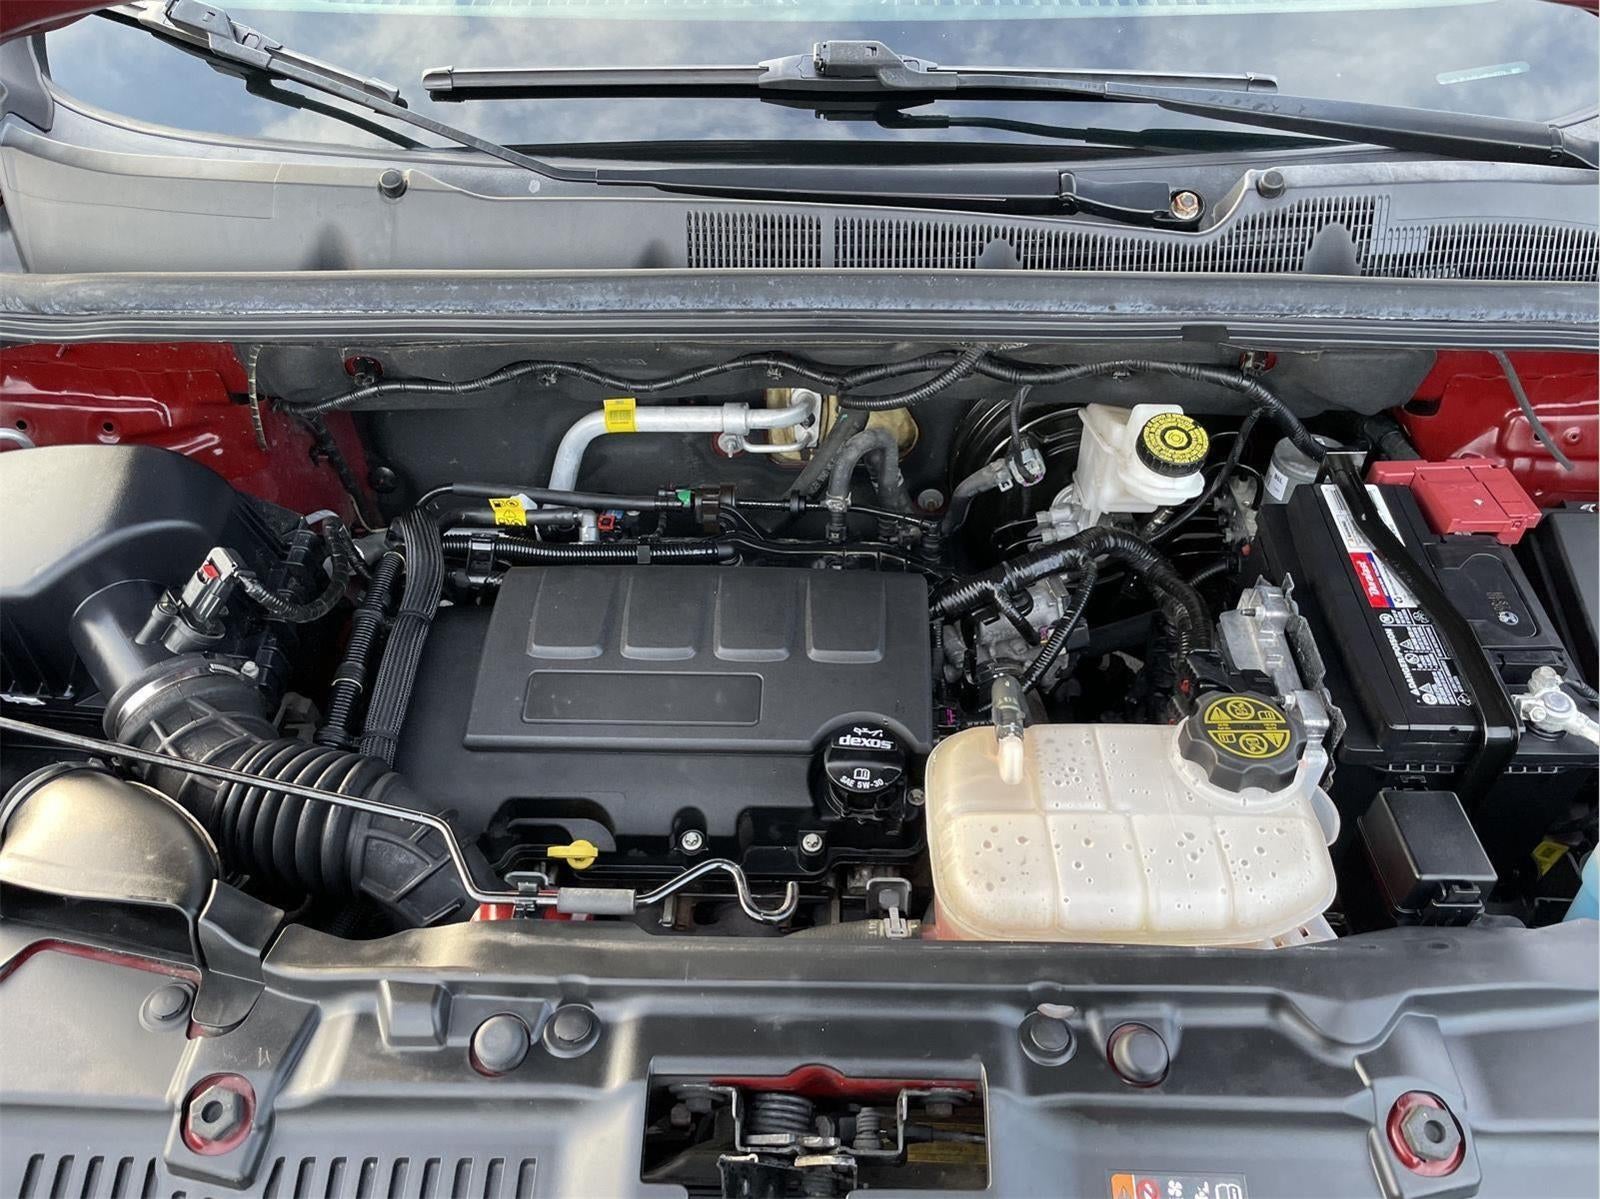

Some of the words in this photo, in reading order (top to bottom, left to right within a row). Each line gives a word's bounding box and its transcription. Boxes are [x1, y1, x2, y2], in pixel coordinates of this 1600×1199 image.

[1356, 560, 1380, 596] Duralast
[838, 734, 894, 749] dexos
[839, 775, 856, 788] SAE
[856, 778, 884, 789] 5W-30
